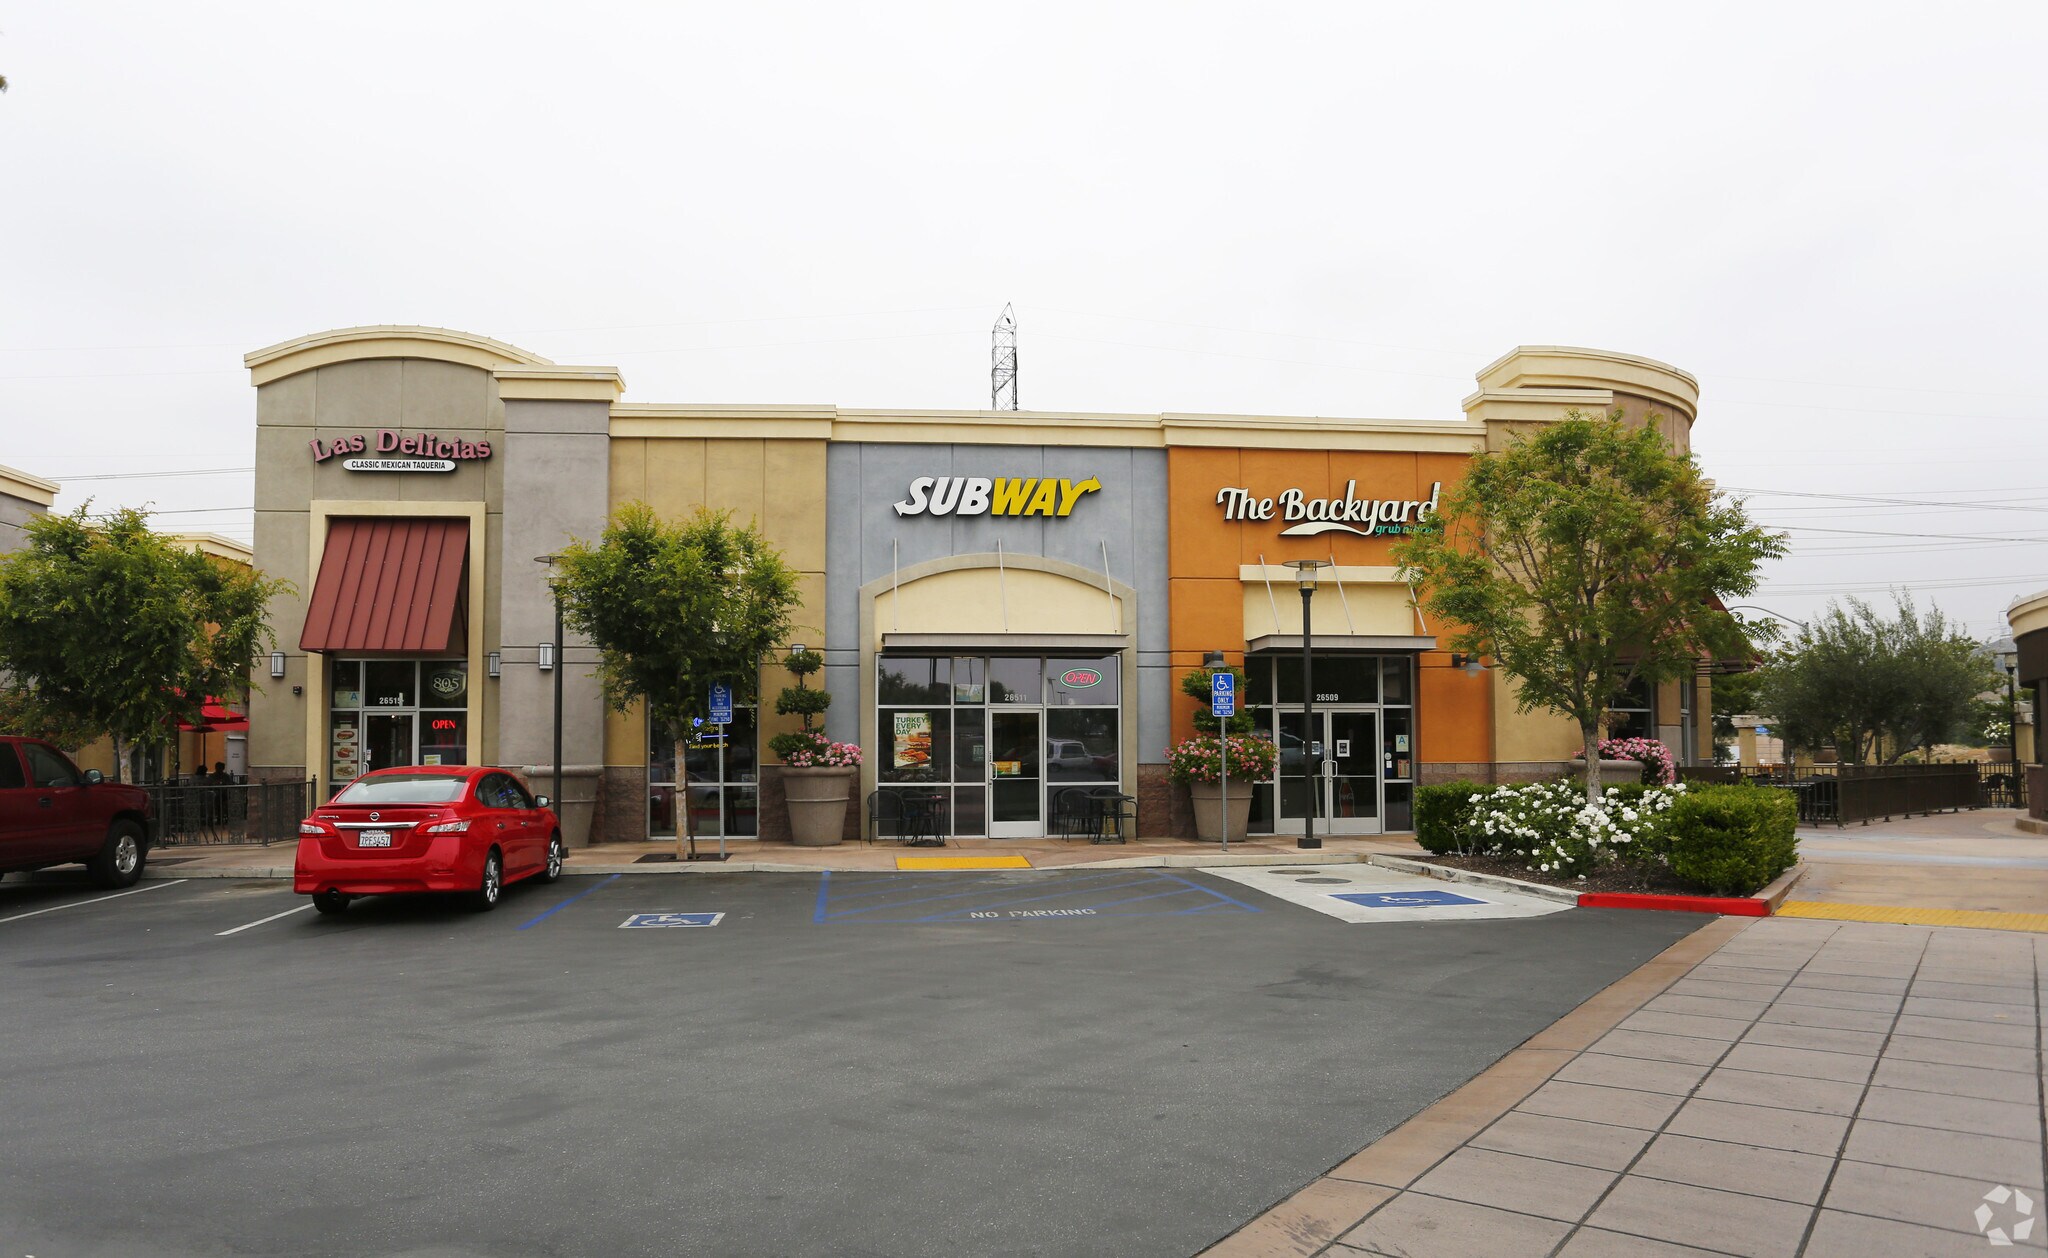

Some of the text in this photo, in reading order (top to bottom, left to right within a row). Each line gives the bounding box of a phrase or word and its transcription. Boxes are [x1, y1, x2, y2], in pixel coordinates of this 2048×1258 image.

[309, 430, 491, 462] Las Delicias
[351, 461, 380, 469] CLASSIC
[381, 461, 411, 469] MEXICAN
[893, 474, 1102, 517] SUBWAY
[1216, 479, 1441, 536] The Backyard
[1375, 523, 1401, 536] grub
[432, 677, 460, 690] 805
[1065, 671, 1097, 684] OPEN
[350, 692, 358, 701] A
[1316, 693, 1339, 701] 26509
[432, 720, 456, 730] OPEN
[1398, 736, 1406, 744] A
[970, 908, 1097, 919] NO PARKING
